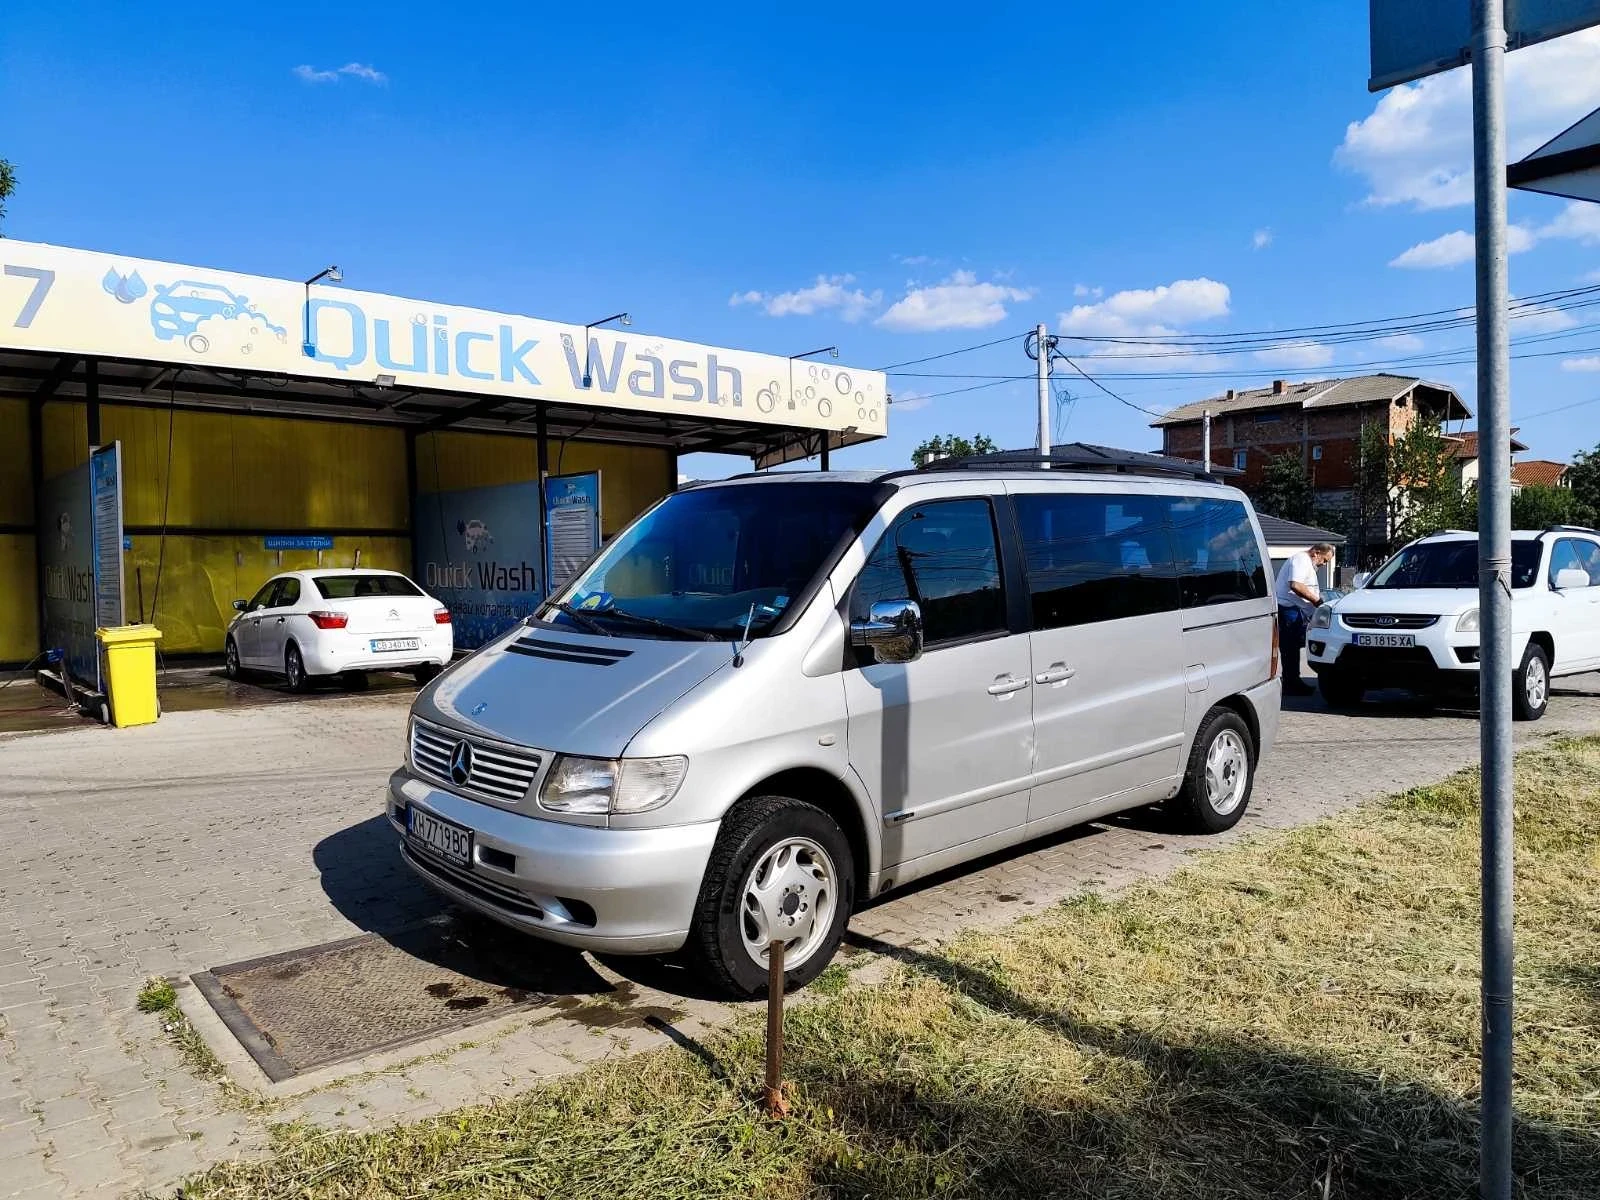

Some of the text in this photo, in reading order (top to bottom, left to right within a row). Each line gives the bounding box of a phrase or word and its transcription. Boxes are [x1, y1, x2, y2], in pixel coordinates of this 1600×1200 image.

[3, 264, 56, 329] 7
[302, 298, 743, 408] Quick Wash
[426, 560, 536, 592] Quick Wash
